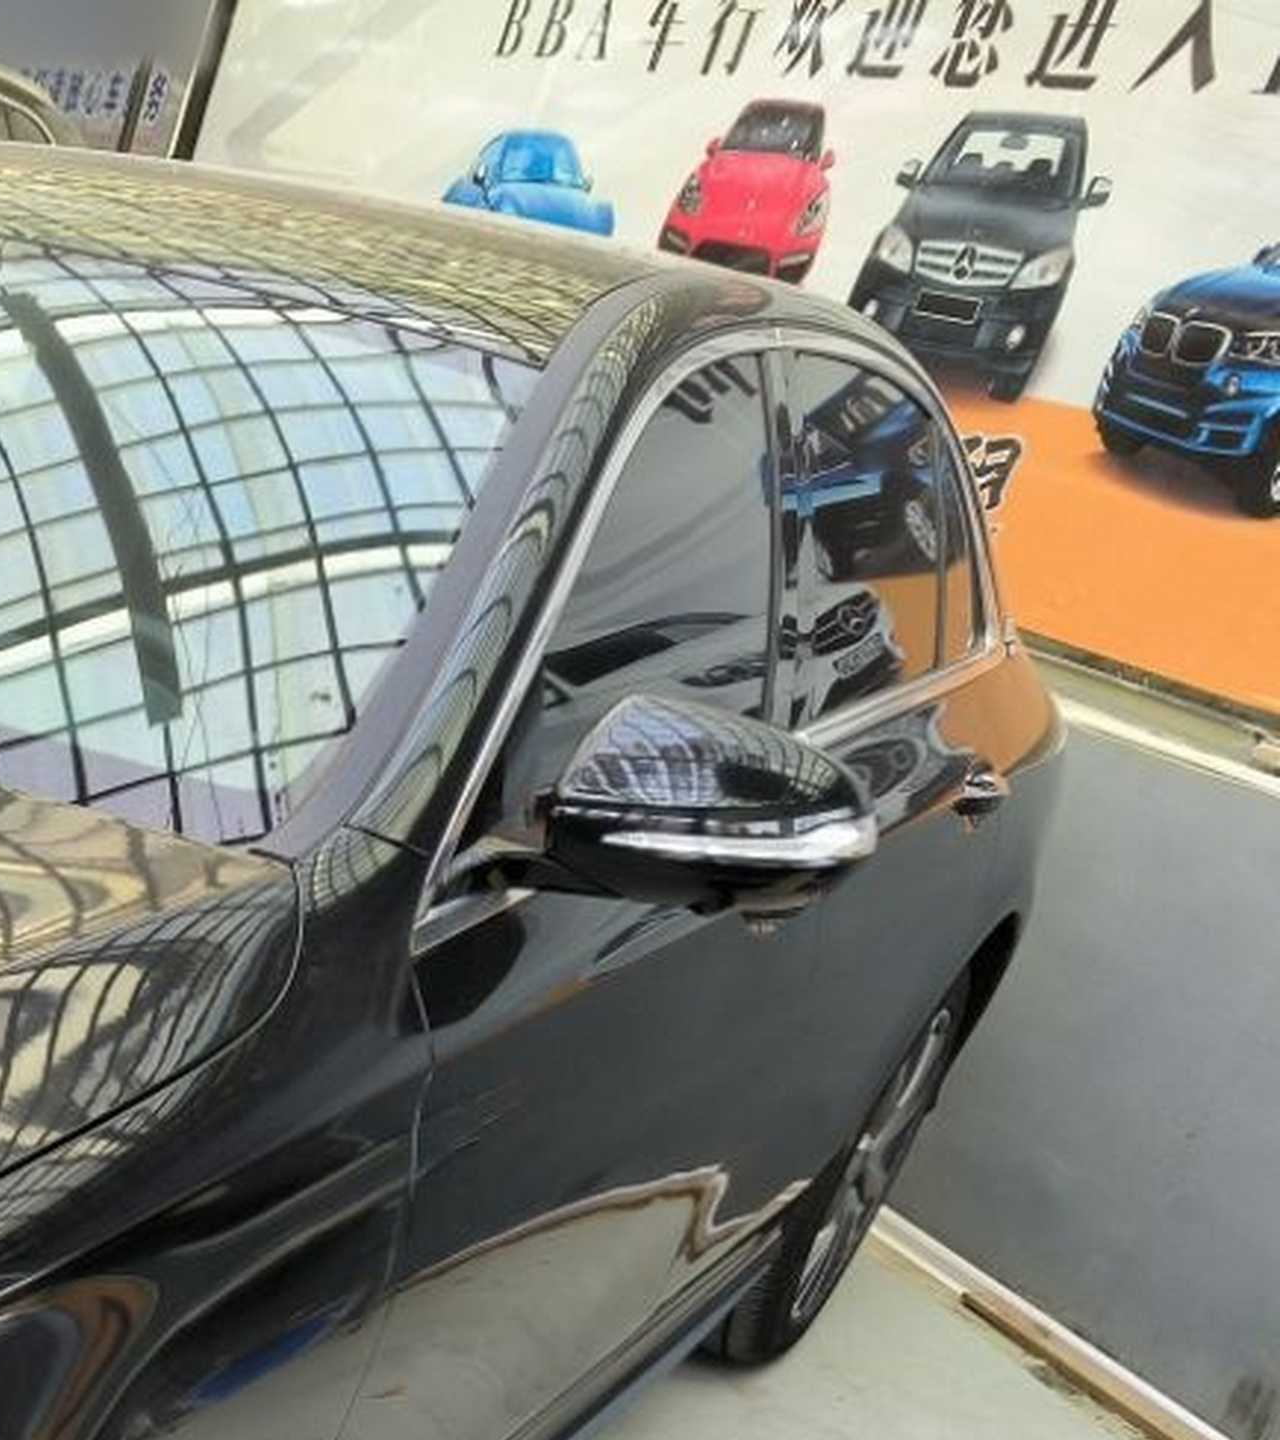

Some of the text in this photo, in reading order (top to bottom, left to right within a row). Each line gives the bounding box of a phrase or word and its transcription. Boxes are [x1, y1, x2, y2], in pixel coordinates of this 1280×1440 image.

[495, 0, 1280, 95] BBA车行欢迎您进入
